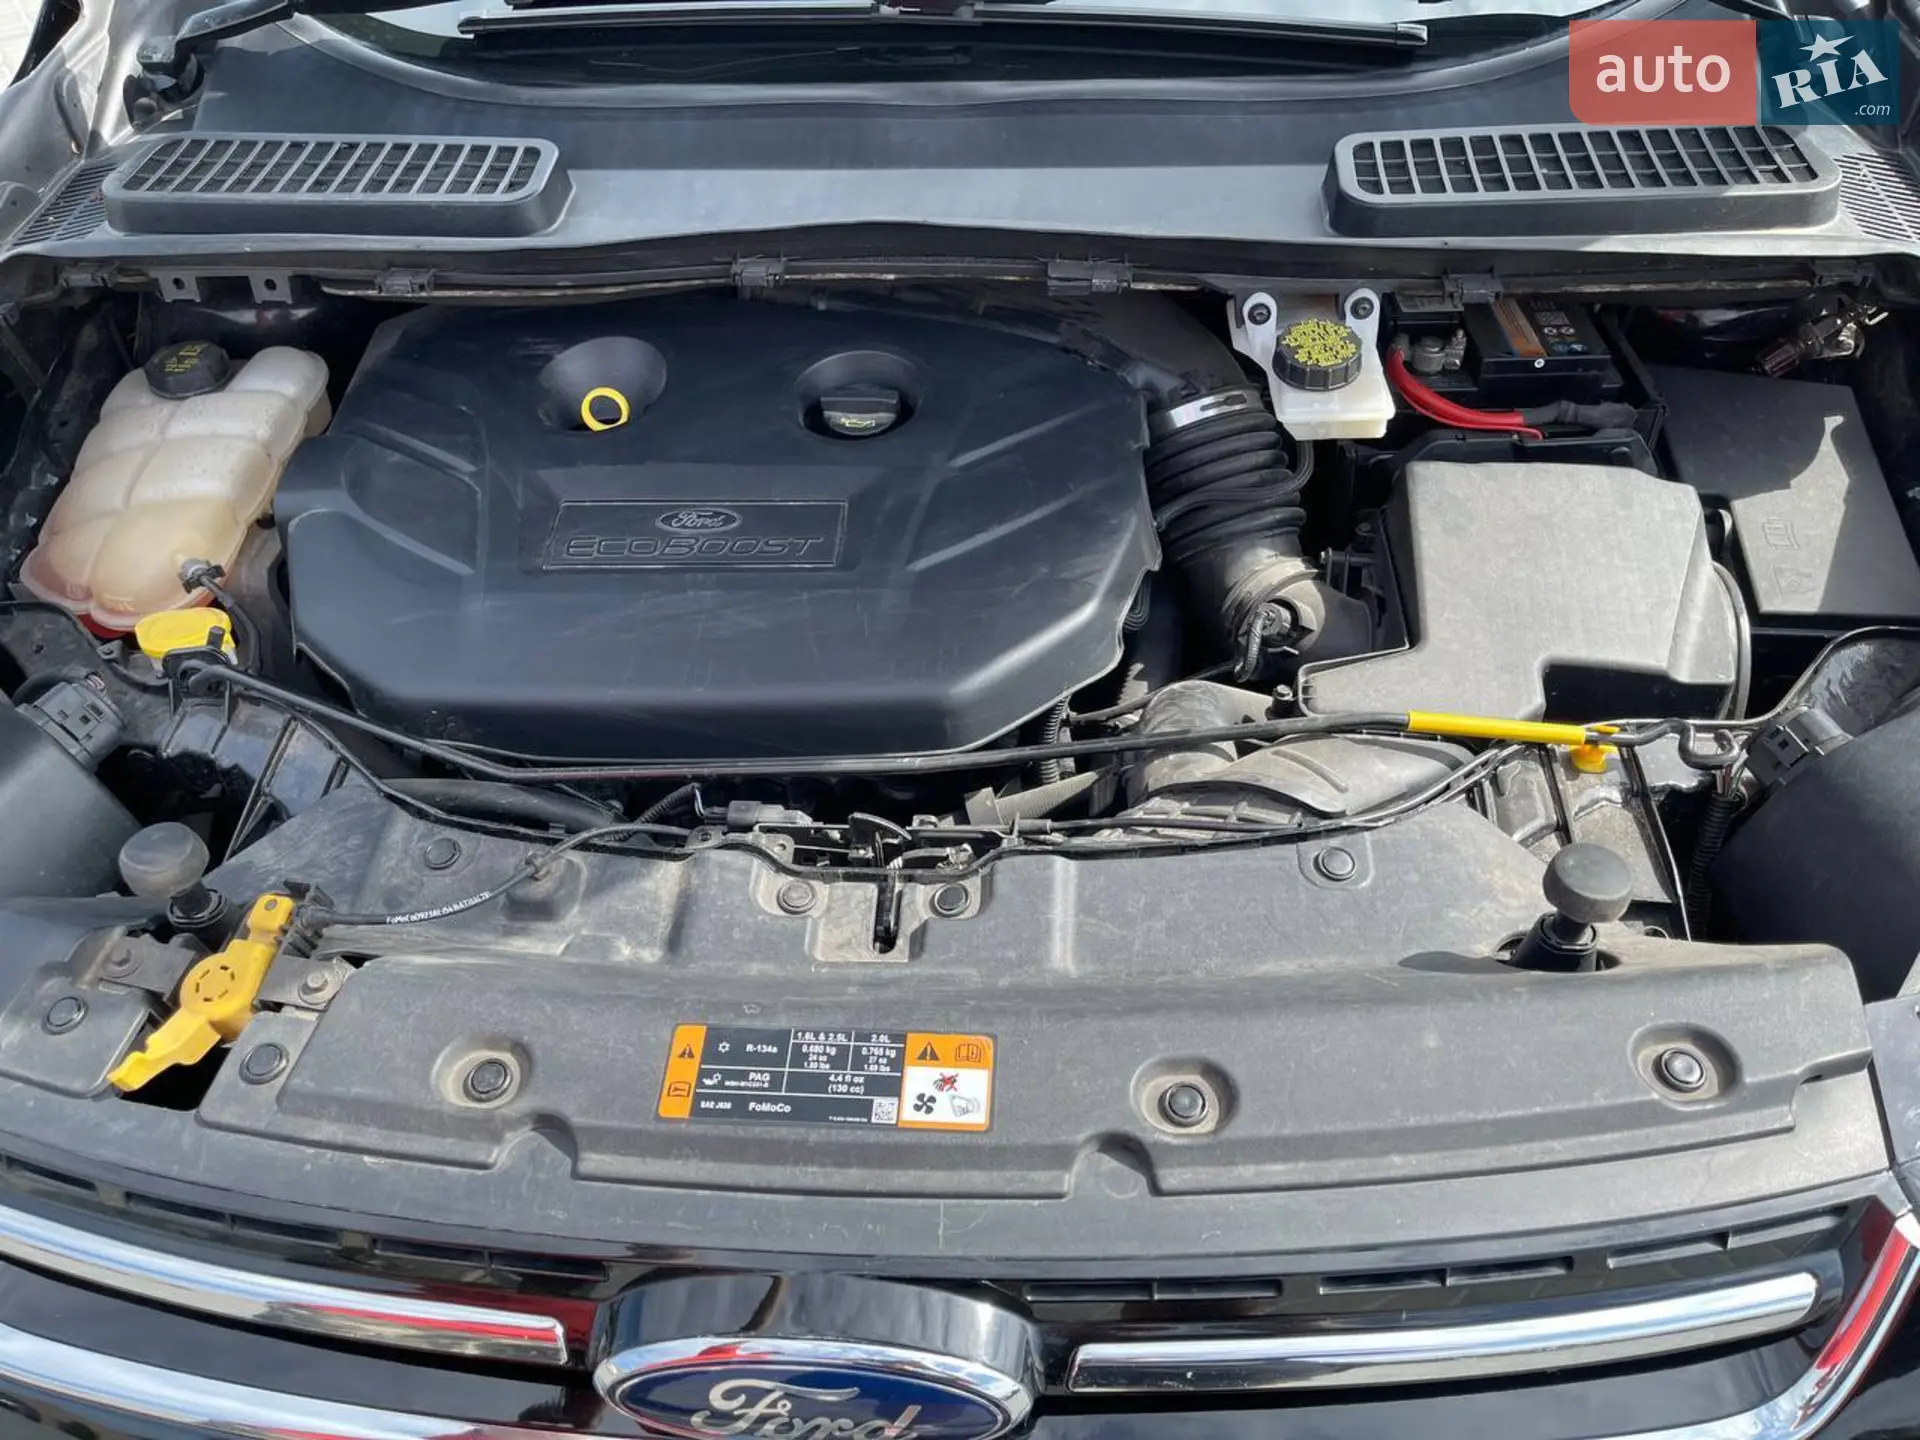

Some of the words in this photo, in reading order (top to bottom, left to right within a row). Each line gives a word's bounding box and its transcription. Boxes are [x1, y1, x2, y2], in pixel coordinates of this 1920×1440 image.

[671, 509, 725, 529] Ford
[872, 1034, 892, 1043] 2.0L
[746, 1044, 778, 1054] R-134a
[826, 1045, 838, 1056] kg
[886, 1048, 898, 1059] kg
[749, 1072, 771, 1082] PAG
[829, 1073, 843, 1082] 4.4
[828, 1083, 849, 1093] (130
[850, 1085, 865, 1095] cc)
[748, 1101, 791, 1113] FoMoCo
[690, 1378, 923, 1440] Ford
